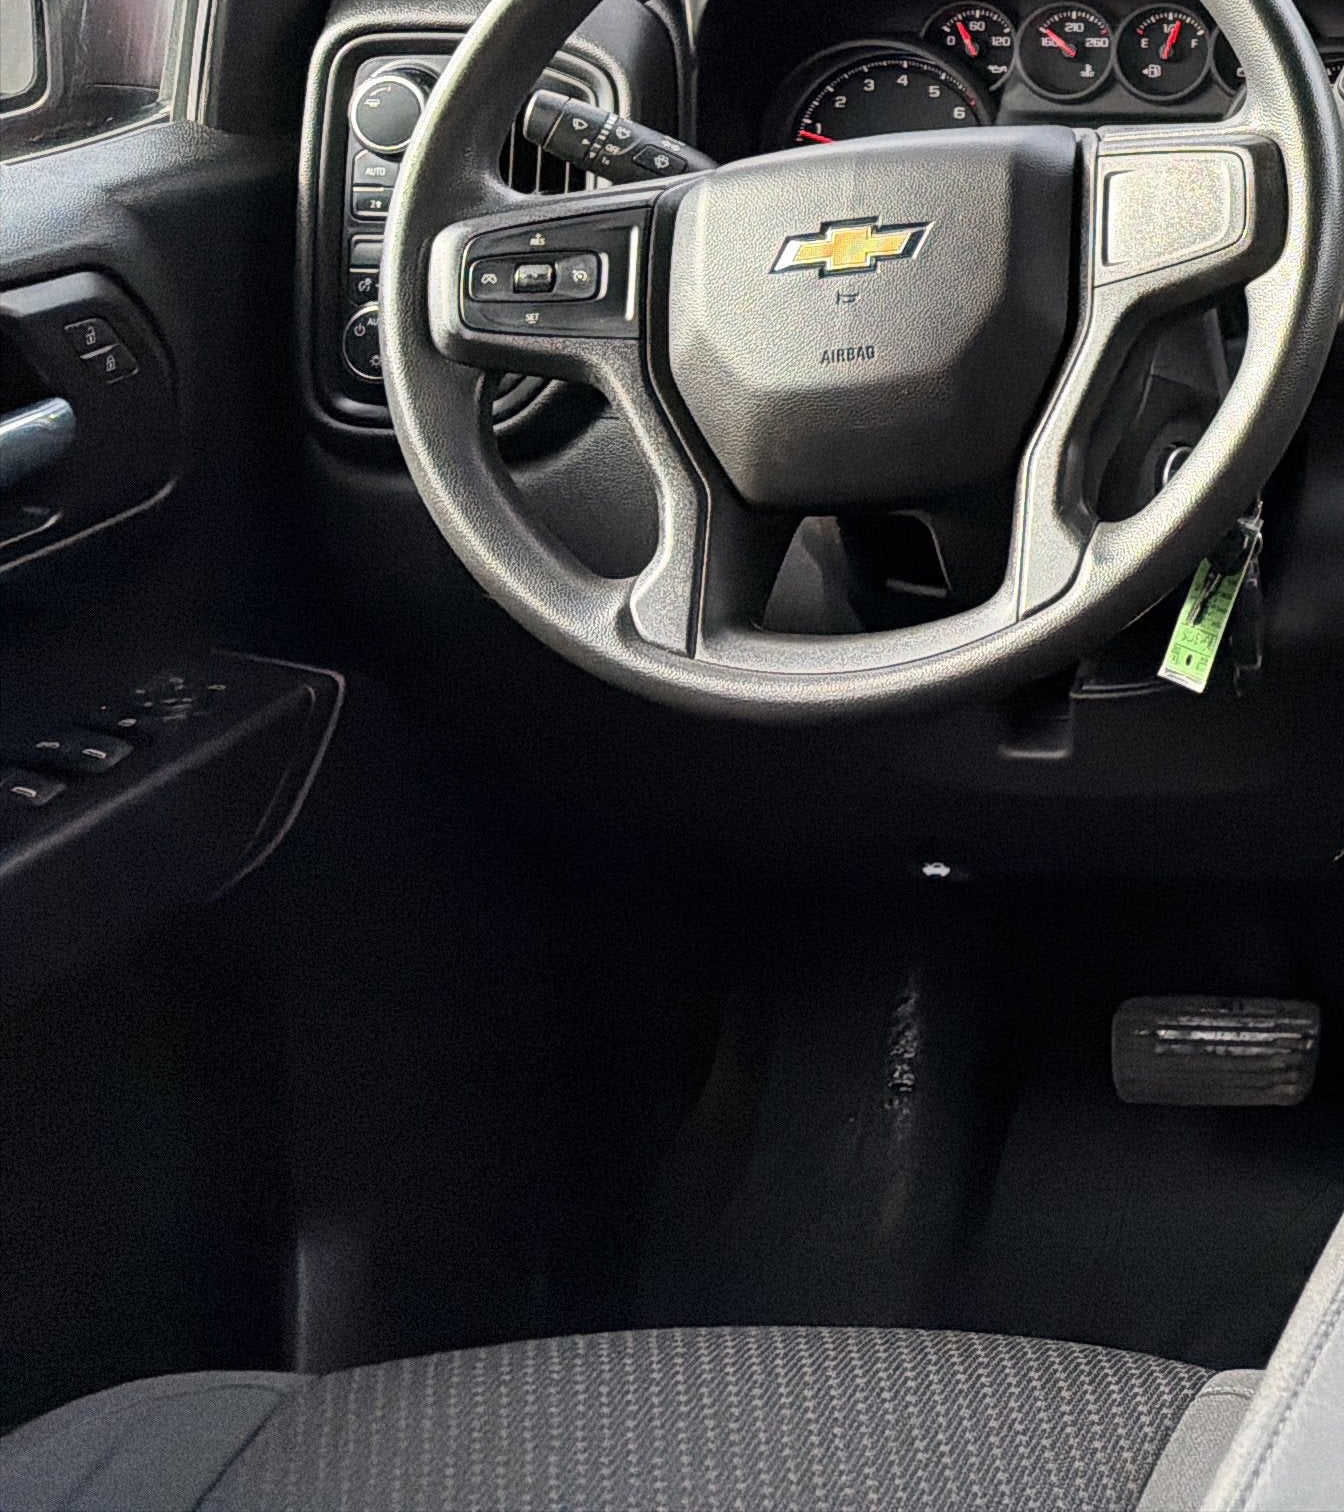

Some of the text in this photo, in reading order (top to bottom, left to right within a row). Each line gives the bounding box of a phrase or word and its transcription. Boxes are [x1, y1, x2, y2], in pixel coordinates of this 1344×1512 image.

[969, 21, 986, 32] 60
[1064, 22, 1085, 33] 210
[946, 35, 956, 46] 0
[991, 36, 1011, 47] 120
[1085, 37, 1109, 48] 260
[1140, 38, 1148, 49] E
[1190, 38, 1199, 49] F
[863, 78, 875, 92] 3
[896, 74, 908, 87] 4
[928, 85, 941, 98] 5
[834, 95, 847, 108] 2
[953, 106, 966, 119] 6
[365, 167, 386, 177] AUTO
[525, 311, 540, 322] SET
[820, 345, 875, 365] AIRBAG
